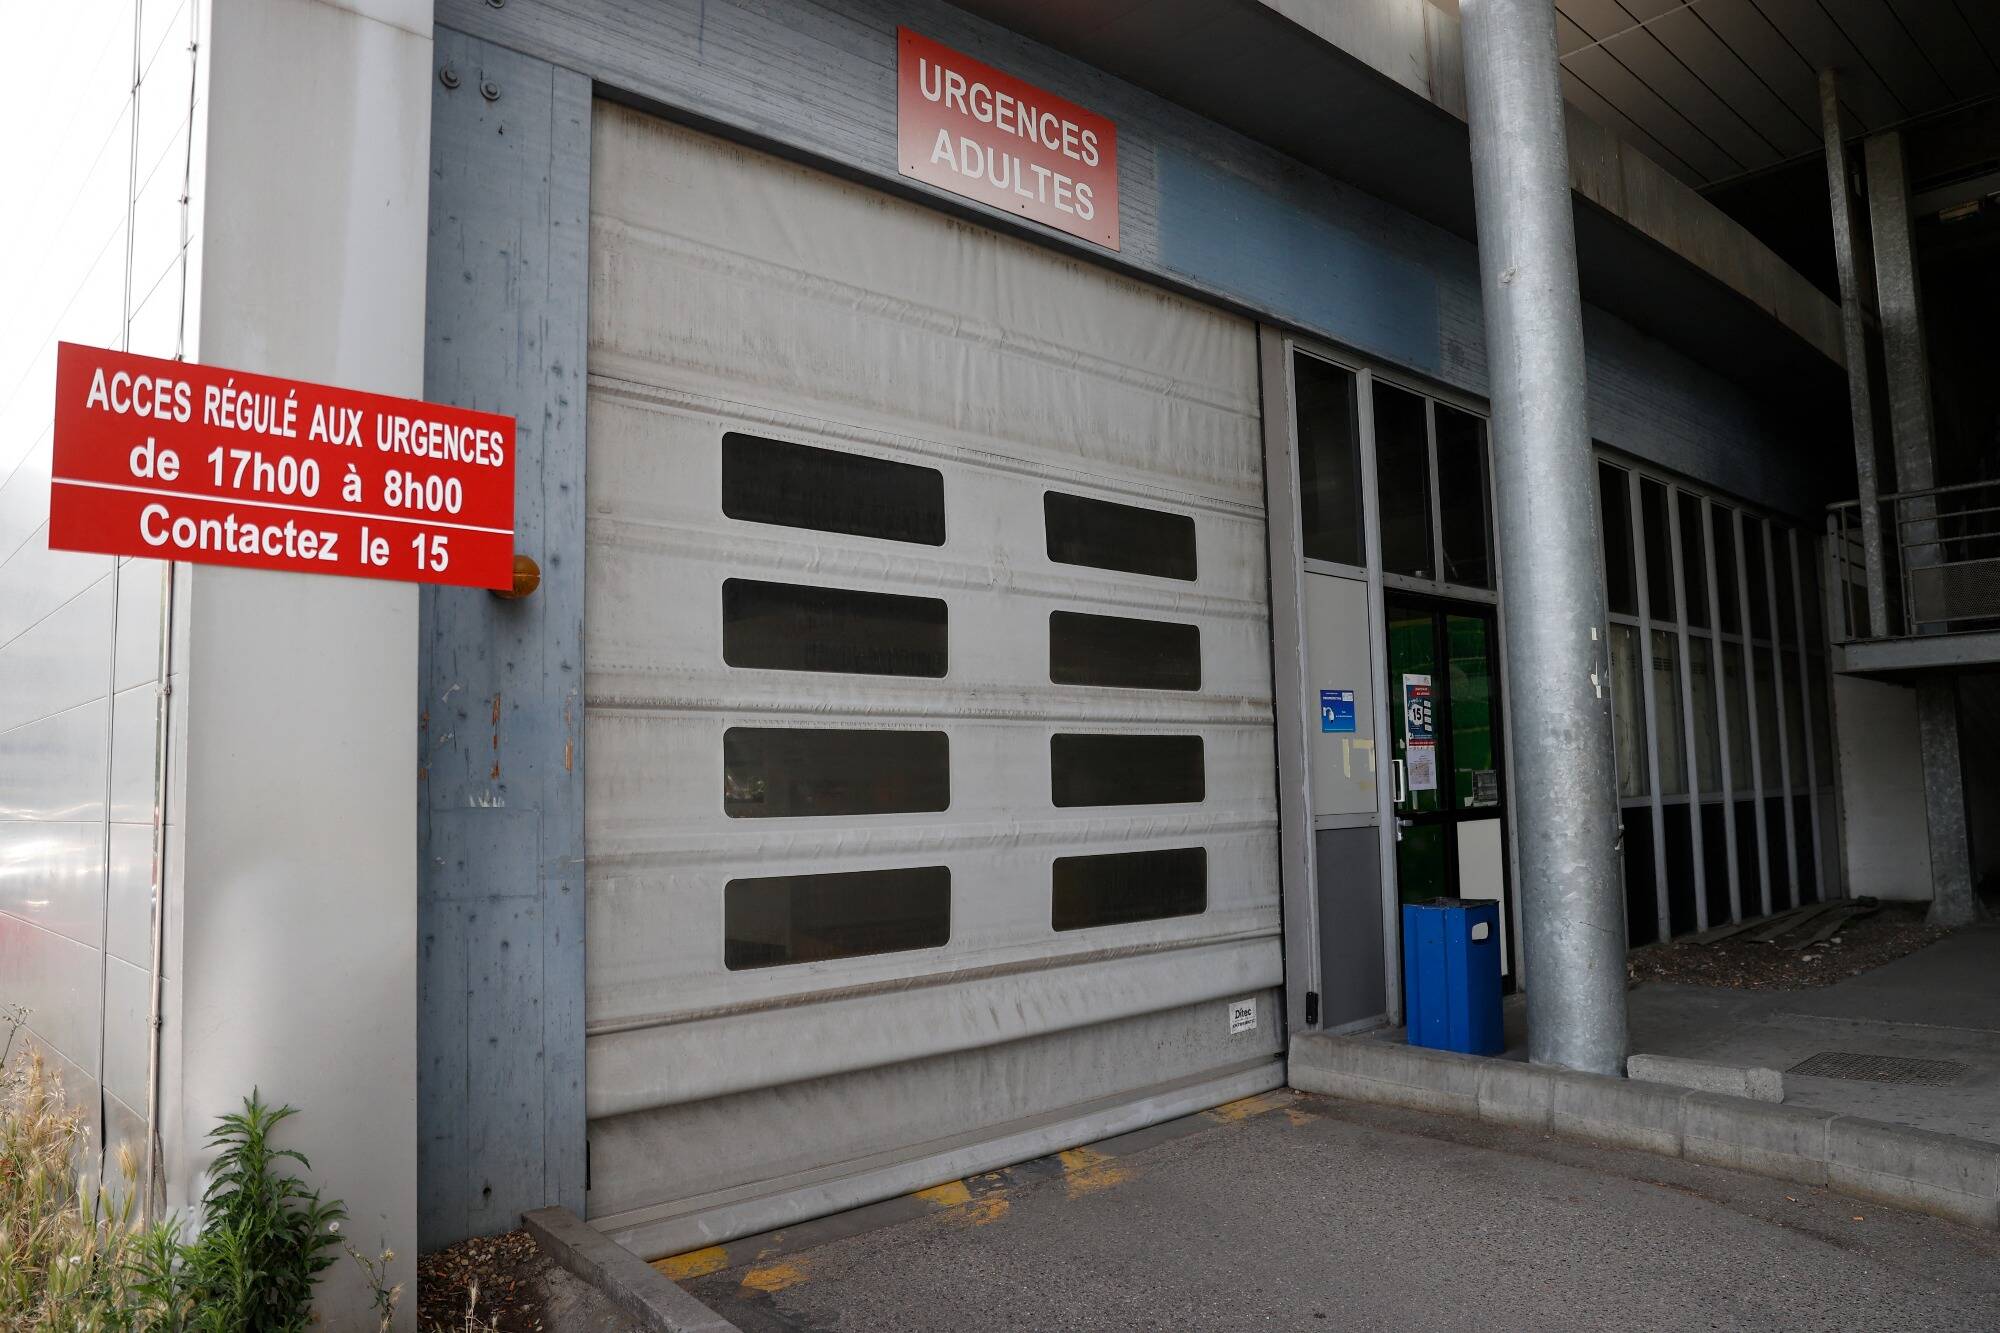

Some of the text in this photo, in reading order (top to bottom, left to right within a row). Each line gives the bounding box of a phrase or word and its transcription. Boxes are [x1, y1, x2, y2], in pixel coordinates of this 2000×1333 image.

[919, 57, 1099, 167] URGENCES
[930, 128, 1095, 221] ADULTES
[86, 367, 504, 467] ACCES RÉGULÉ AUX URGENCES
[130, 437, 463, 514] de 17h00 à 8h00
[140, 504, 449, 572] Contactez le 15
[1412, 707, 1422, 721] 15
